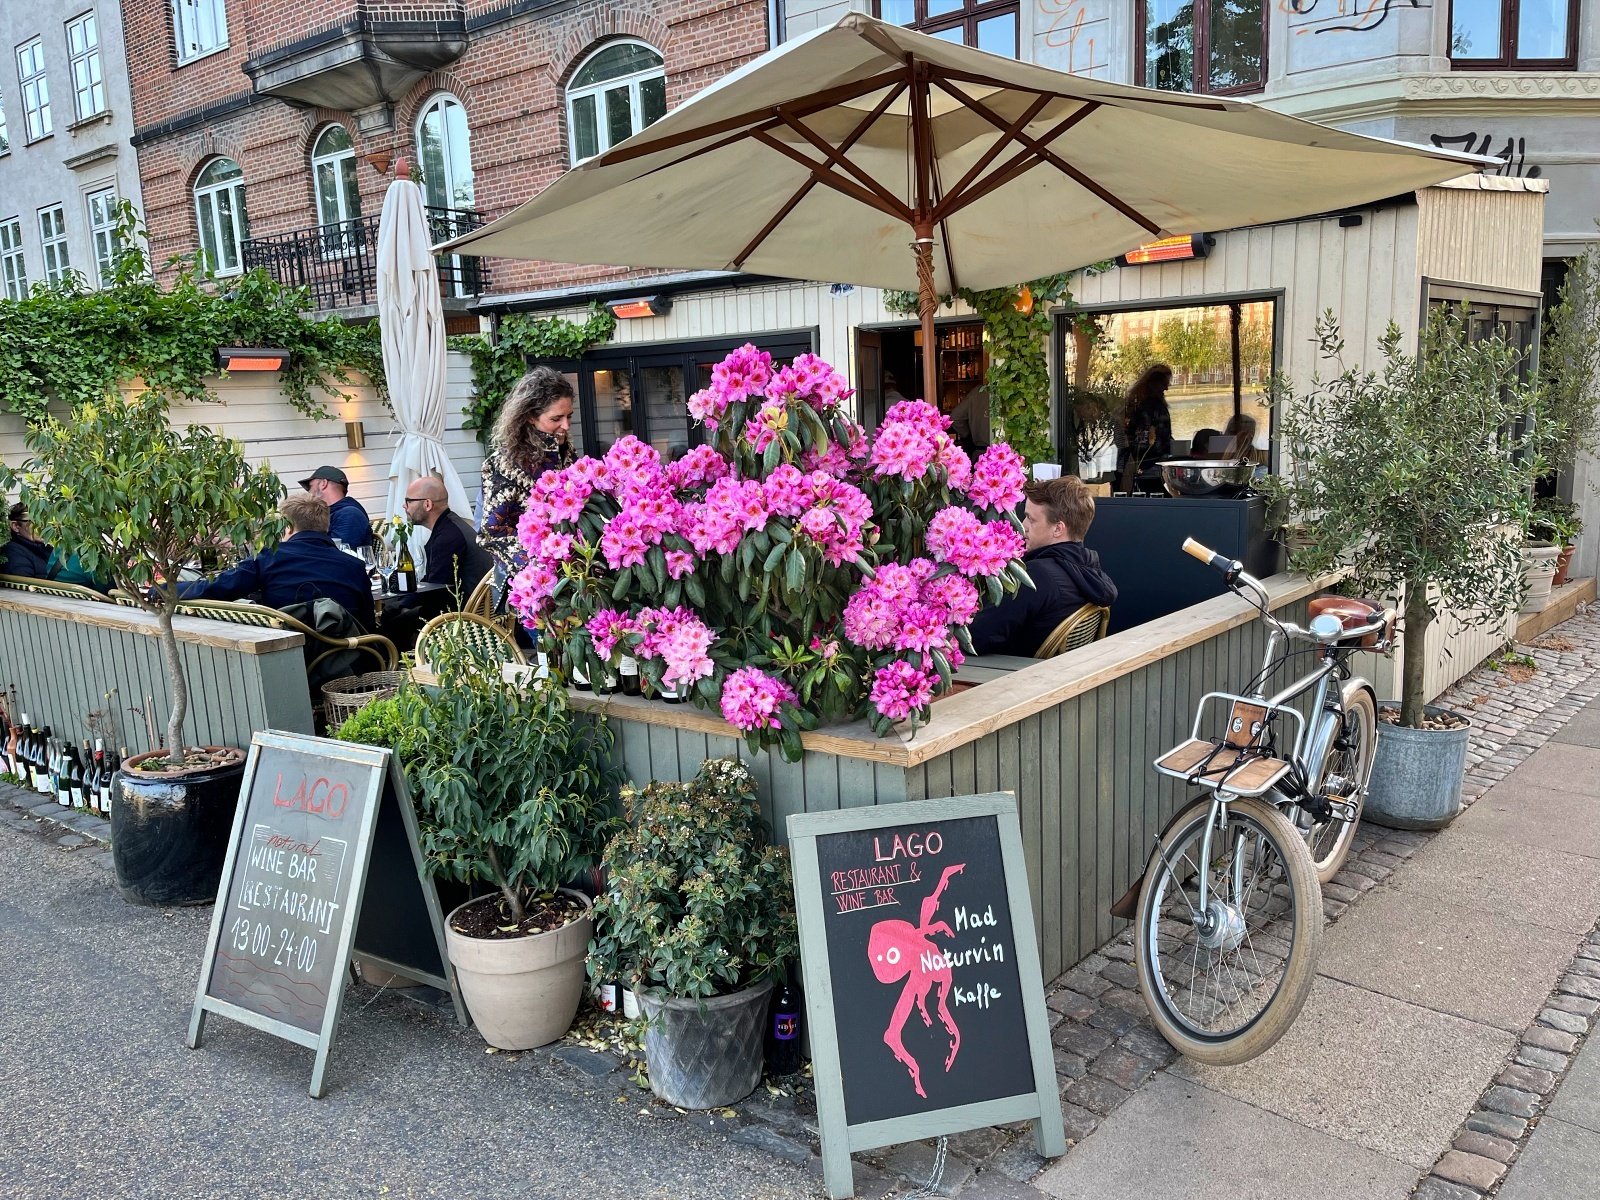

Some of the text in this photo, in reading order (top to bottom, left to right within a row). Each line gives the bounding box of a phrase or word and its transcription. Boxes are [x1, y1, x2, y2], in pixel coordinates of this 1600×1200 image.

[272, 771, 349, 818] LAGO
[874, 831, 944, 862] LAGO
[251, 846, 318, 883] WINE BAR
[830, 861, 922, 892] RESTAURANT &
[243, 880, 340, 934] RESTAURANT
[836, 887, 901, 913] WINE BAR
[954, 904, 997, 932] Mad
[919, 936, 1004, 974] Naturvin
[953, 982, 1002, 1009] Kaffe
